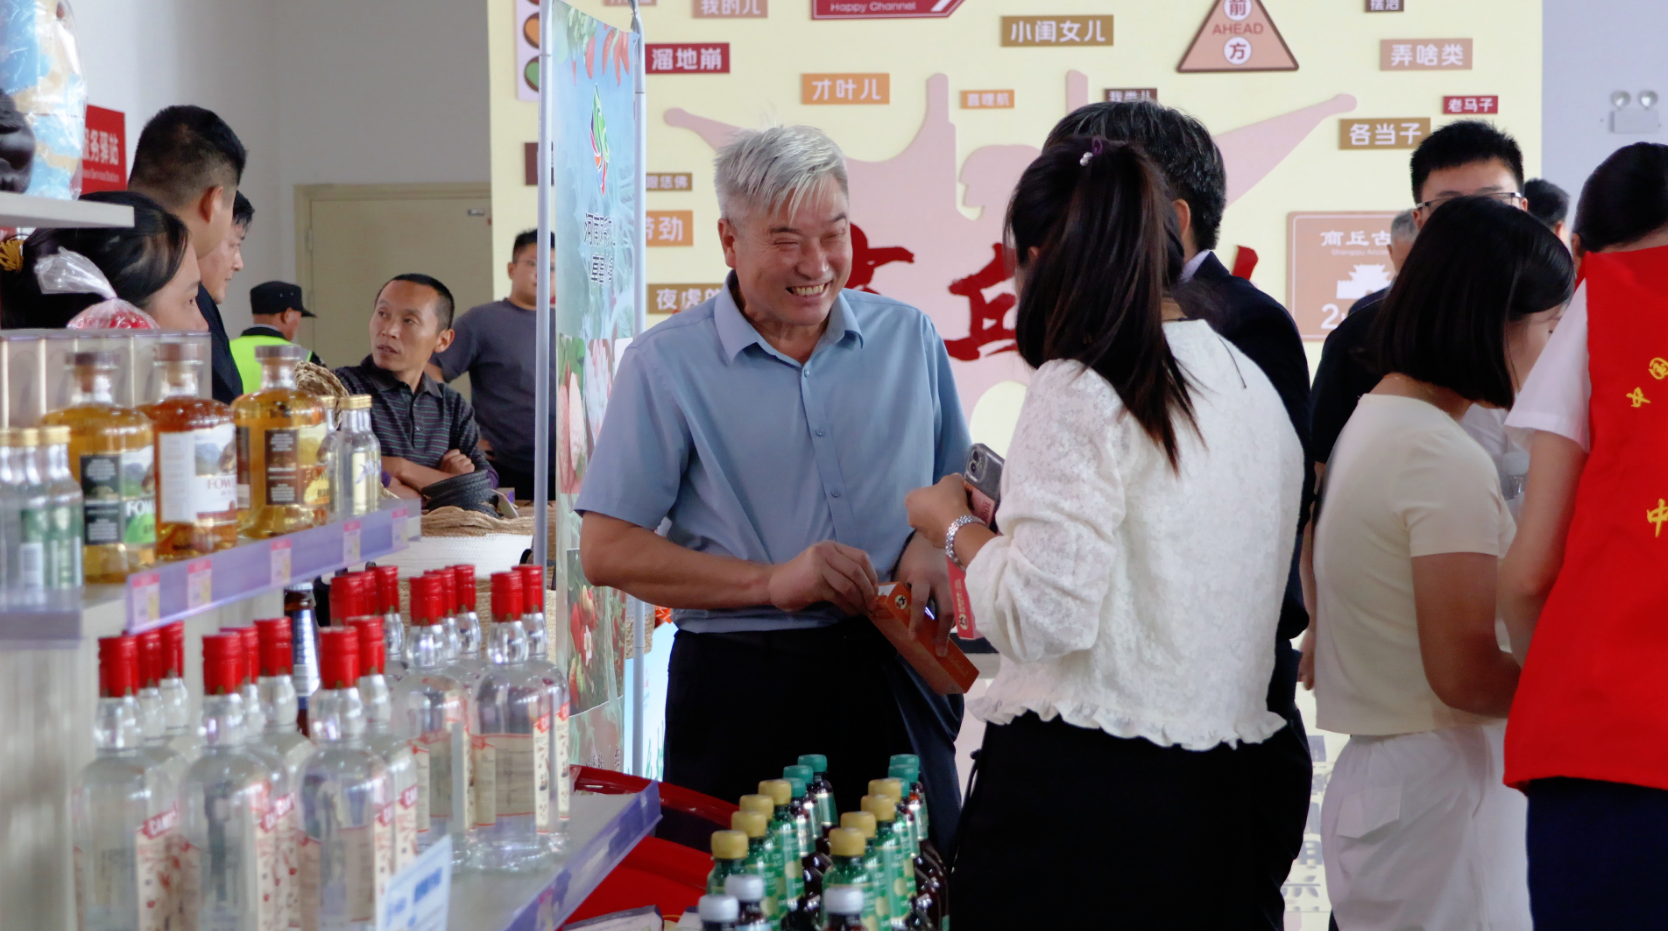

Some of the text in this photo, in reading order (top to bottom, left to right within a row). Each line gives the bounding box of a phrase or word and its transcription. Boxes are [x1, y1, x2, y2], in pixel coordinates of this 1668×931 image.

[830, 1, 916, 13] Happy Channel
[1010, 20, 1106, 43] 小闺女儿
[1212, 23, 1264, 35] AHEAD
[652, 47, 722, 71] 溜地崩
[1229, 43, 1247, 60] 方
[1391, 44, 1463, 66] 弄啥类
[1448, 98, 1493, 113] 老马子
[1350, 122, 1422, 146] 各当子
